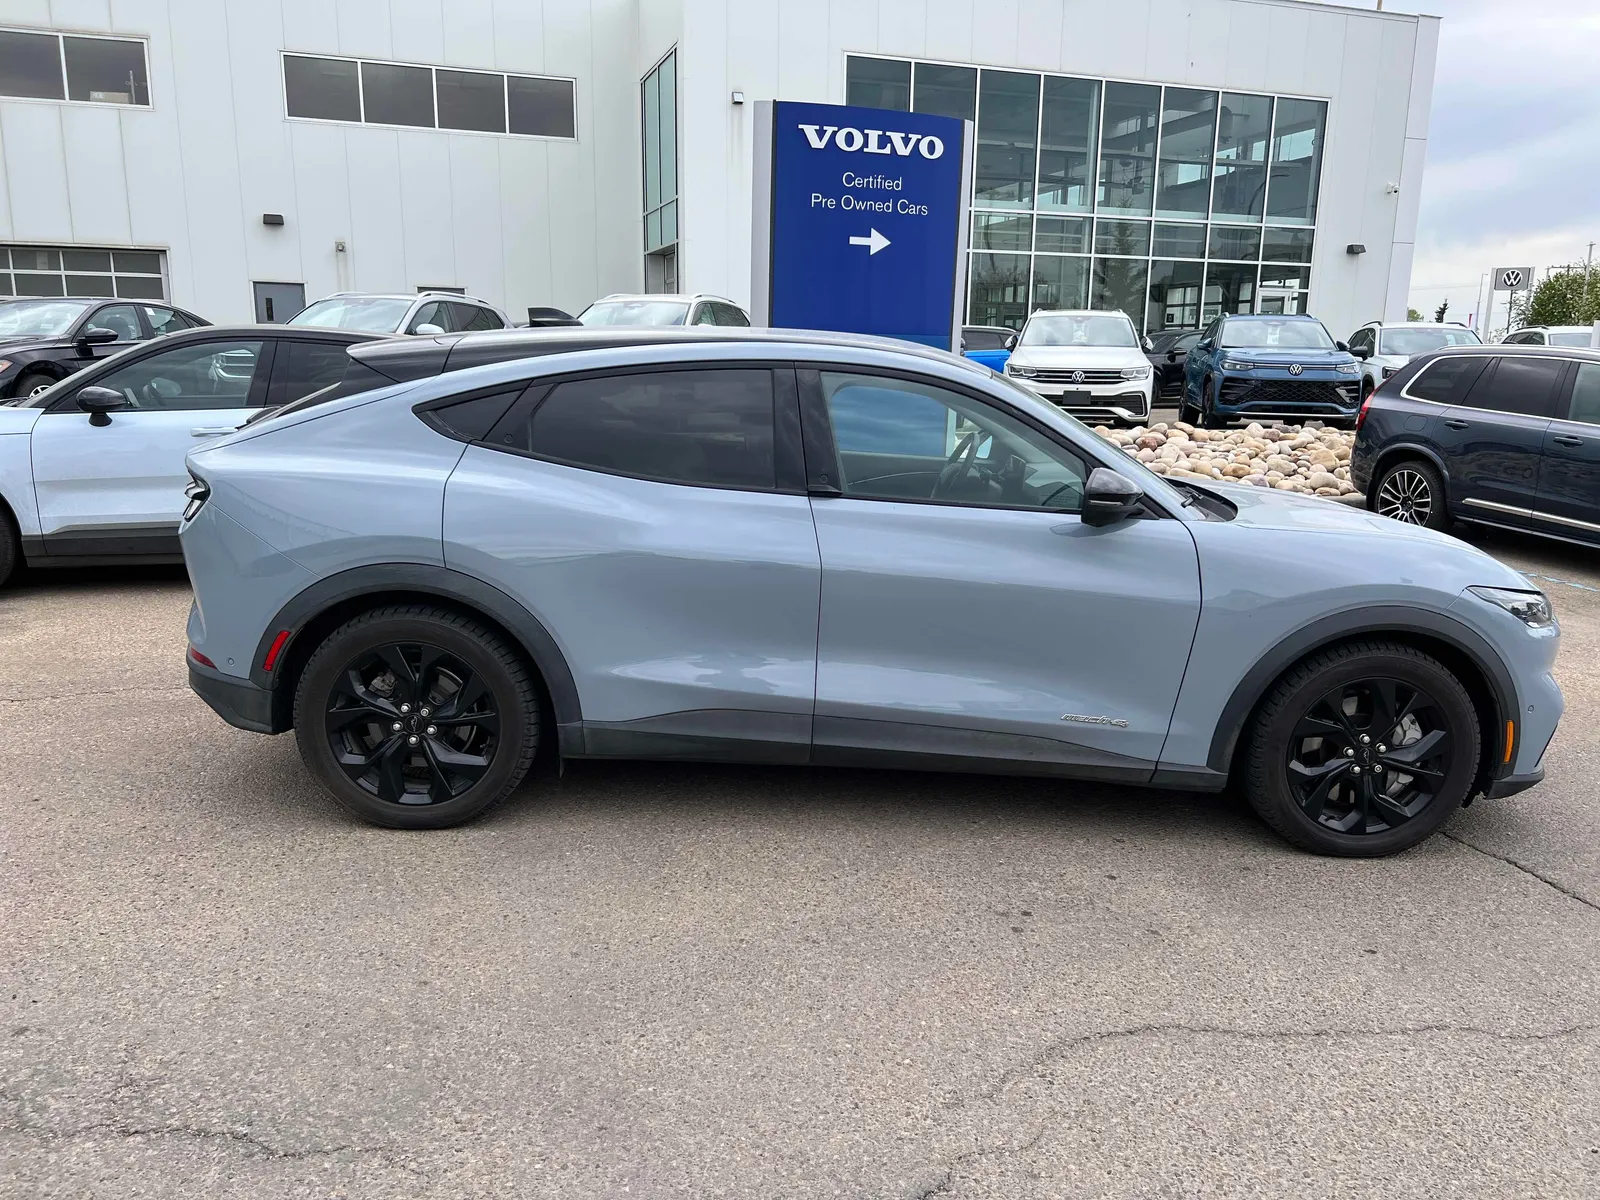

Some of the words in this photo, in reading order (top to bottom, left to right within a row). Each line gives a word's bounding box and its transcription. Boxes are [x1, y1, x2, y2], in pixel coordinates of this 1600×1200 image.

[798, 124, 944, 160] VOLVO
[842, 171, 903, 191] Certified
[811, 193, 836, 210] Pre
[841, 195, 892, 213] Owned
[897, 199, 928, 216] Cars
[1503, 270, 1522, 287] VW
